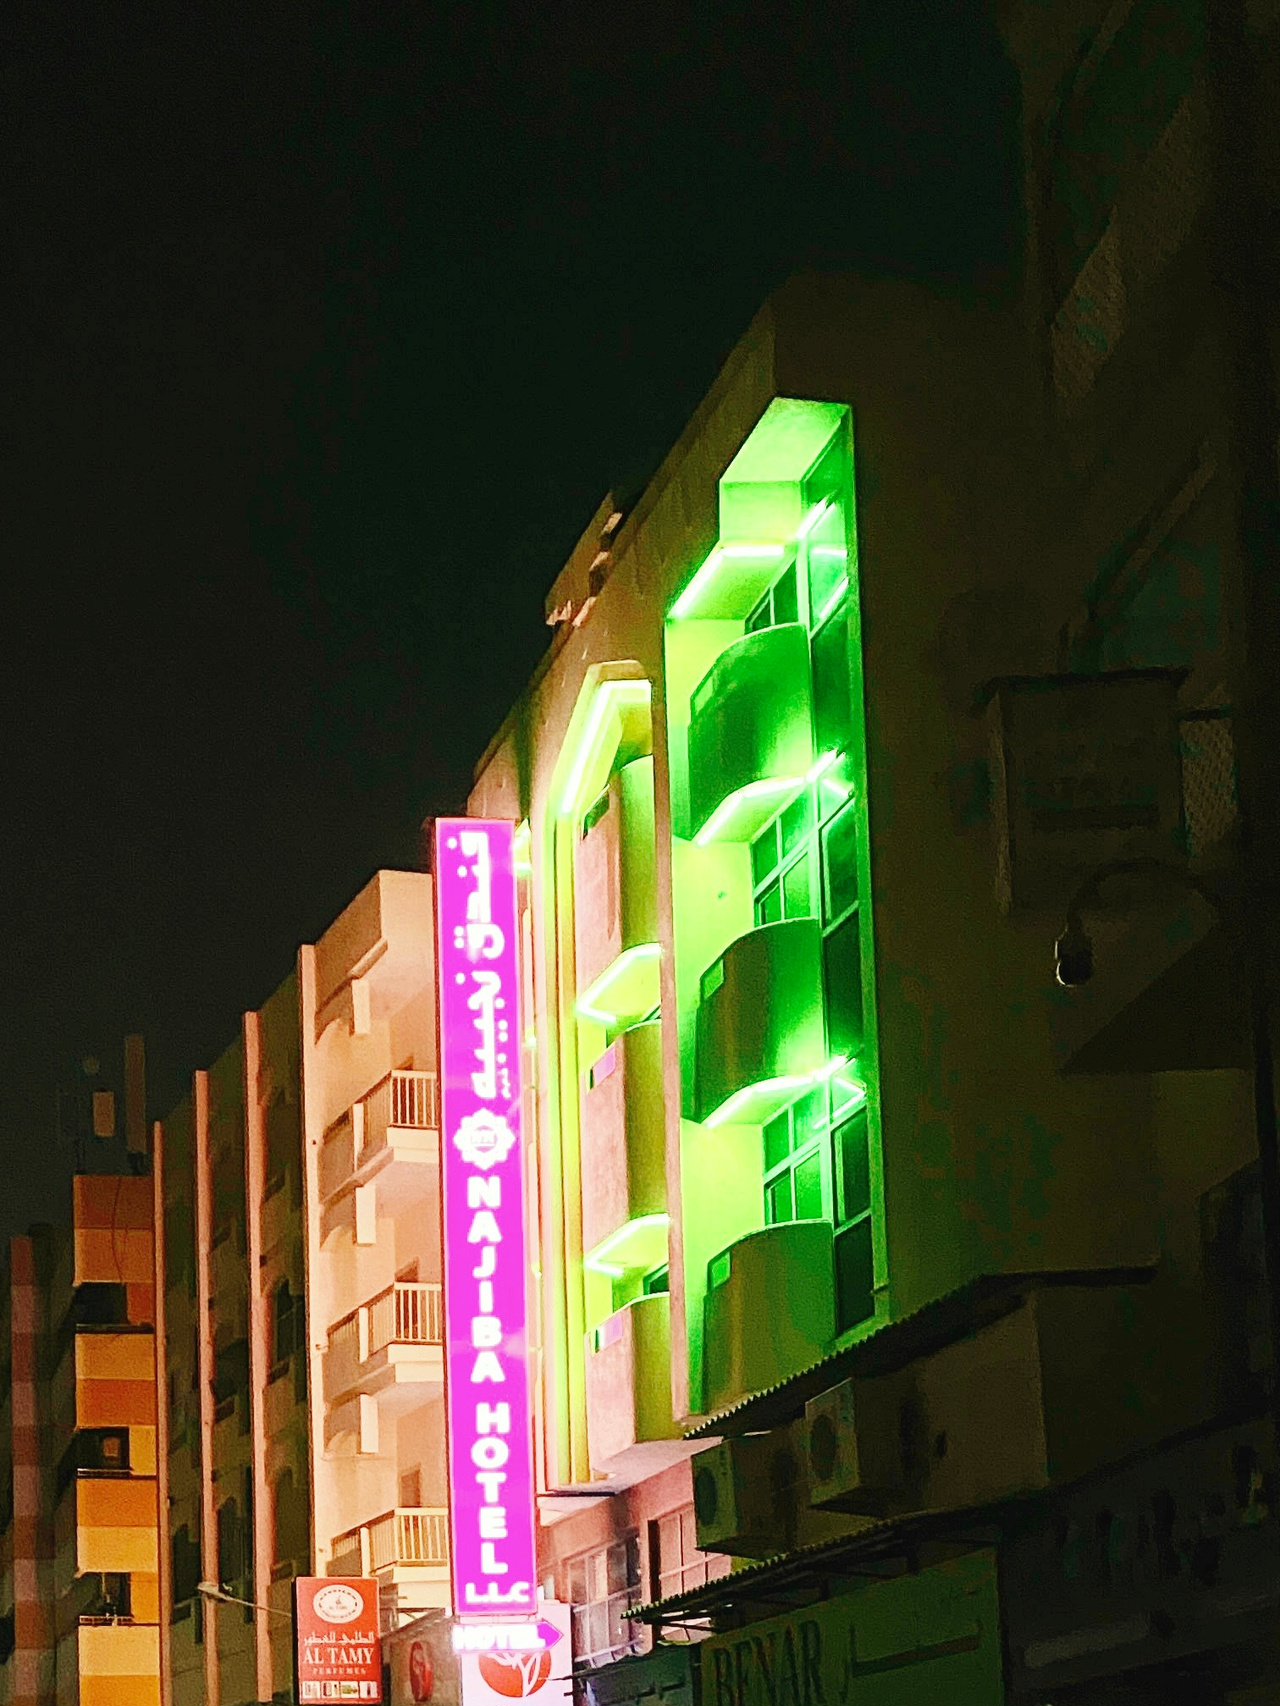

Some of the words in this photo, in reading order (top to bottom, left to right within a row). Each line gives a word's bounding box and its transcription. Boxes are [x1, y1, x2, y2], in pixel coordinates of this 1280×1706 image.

[447, 830, 506, 961] فندق
[467, 1176, 503, 1384] NAJIBA
[470, 1402, 511, 1575] HOTEL
[303, 1647, 324, 1665] AL
[327, 1647, 374, 1665] TAMY
[313, 1667, 367, 1676] PERFUMES
[454, 1625, 546, 1651] HOTEL
